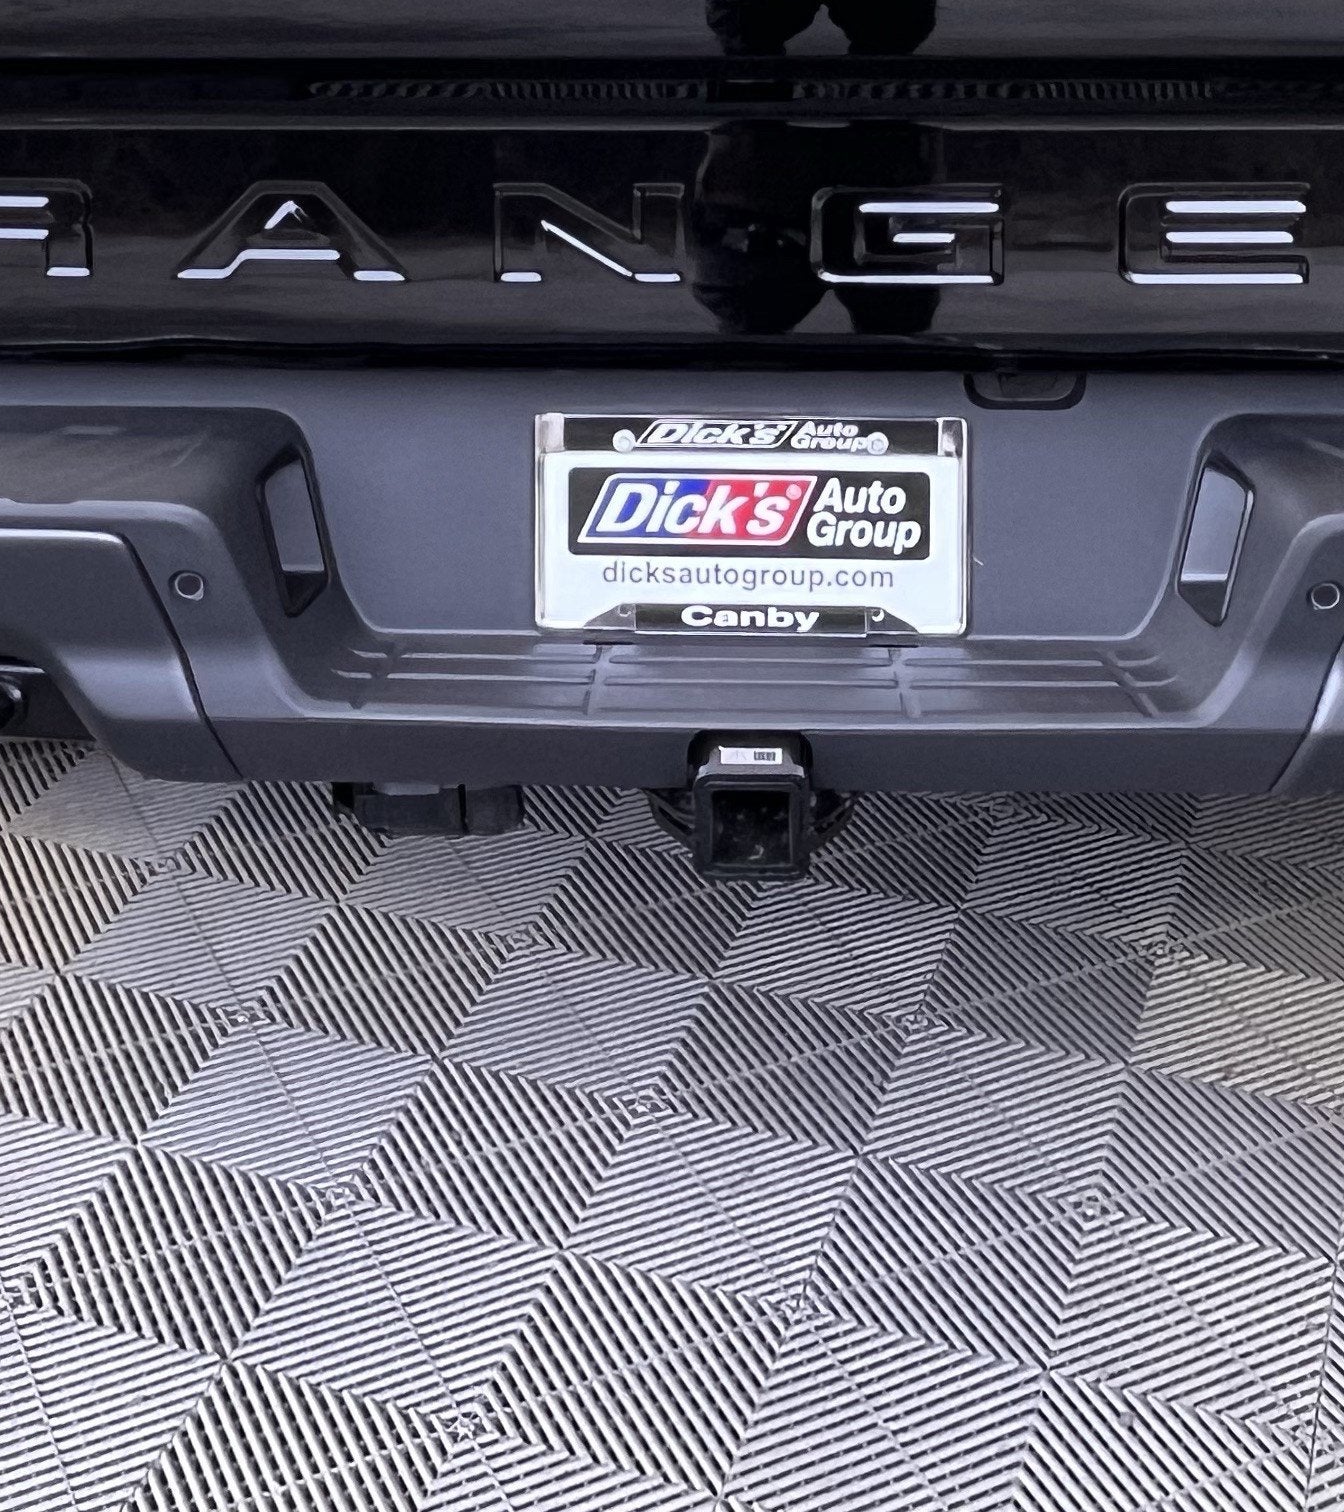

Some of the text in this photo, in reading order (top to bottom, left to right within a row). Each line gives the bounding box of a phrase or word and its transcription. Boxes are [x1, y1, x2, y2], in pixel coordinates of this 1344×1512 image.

[790, 436, 868, 453] Group
[799, 421, 859, 438] Auto
[596, 480, 791, 536] Dick's
[813, 477, 907, 515] Auto
[806, 511, 922, 555] Group
[602, 560, 895, 593] dicksautogroup.com
[680, 604, 820, 633] Canby
